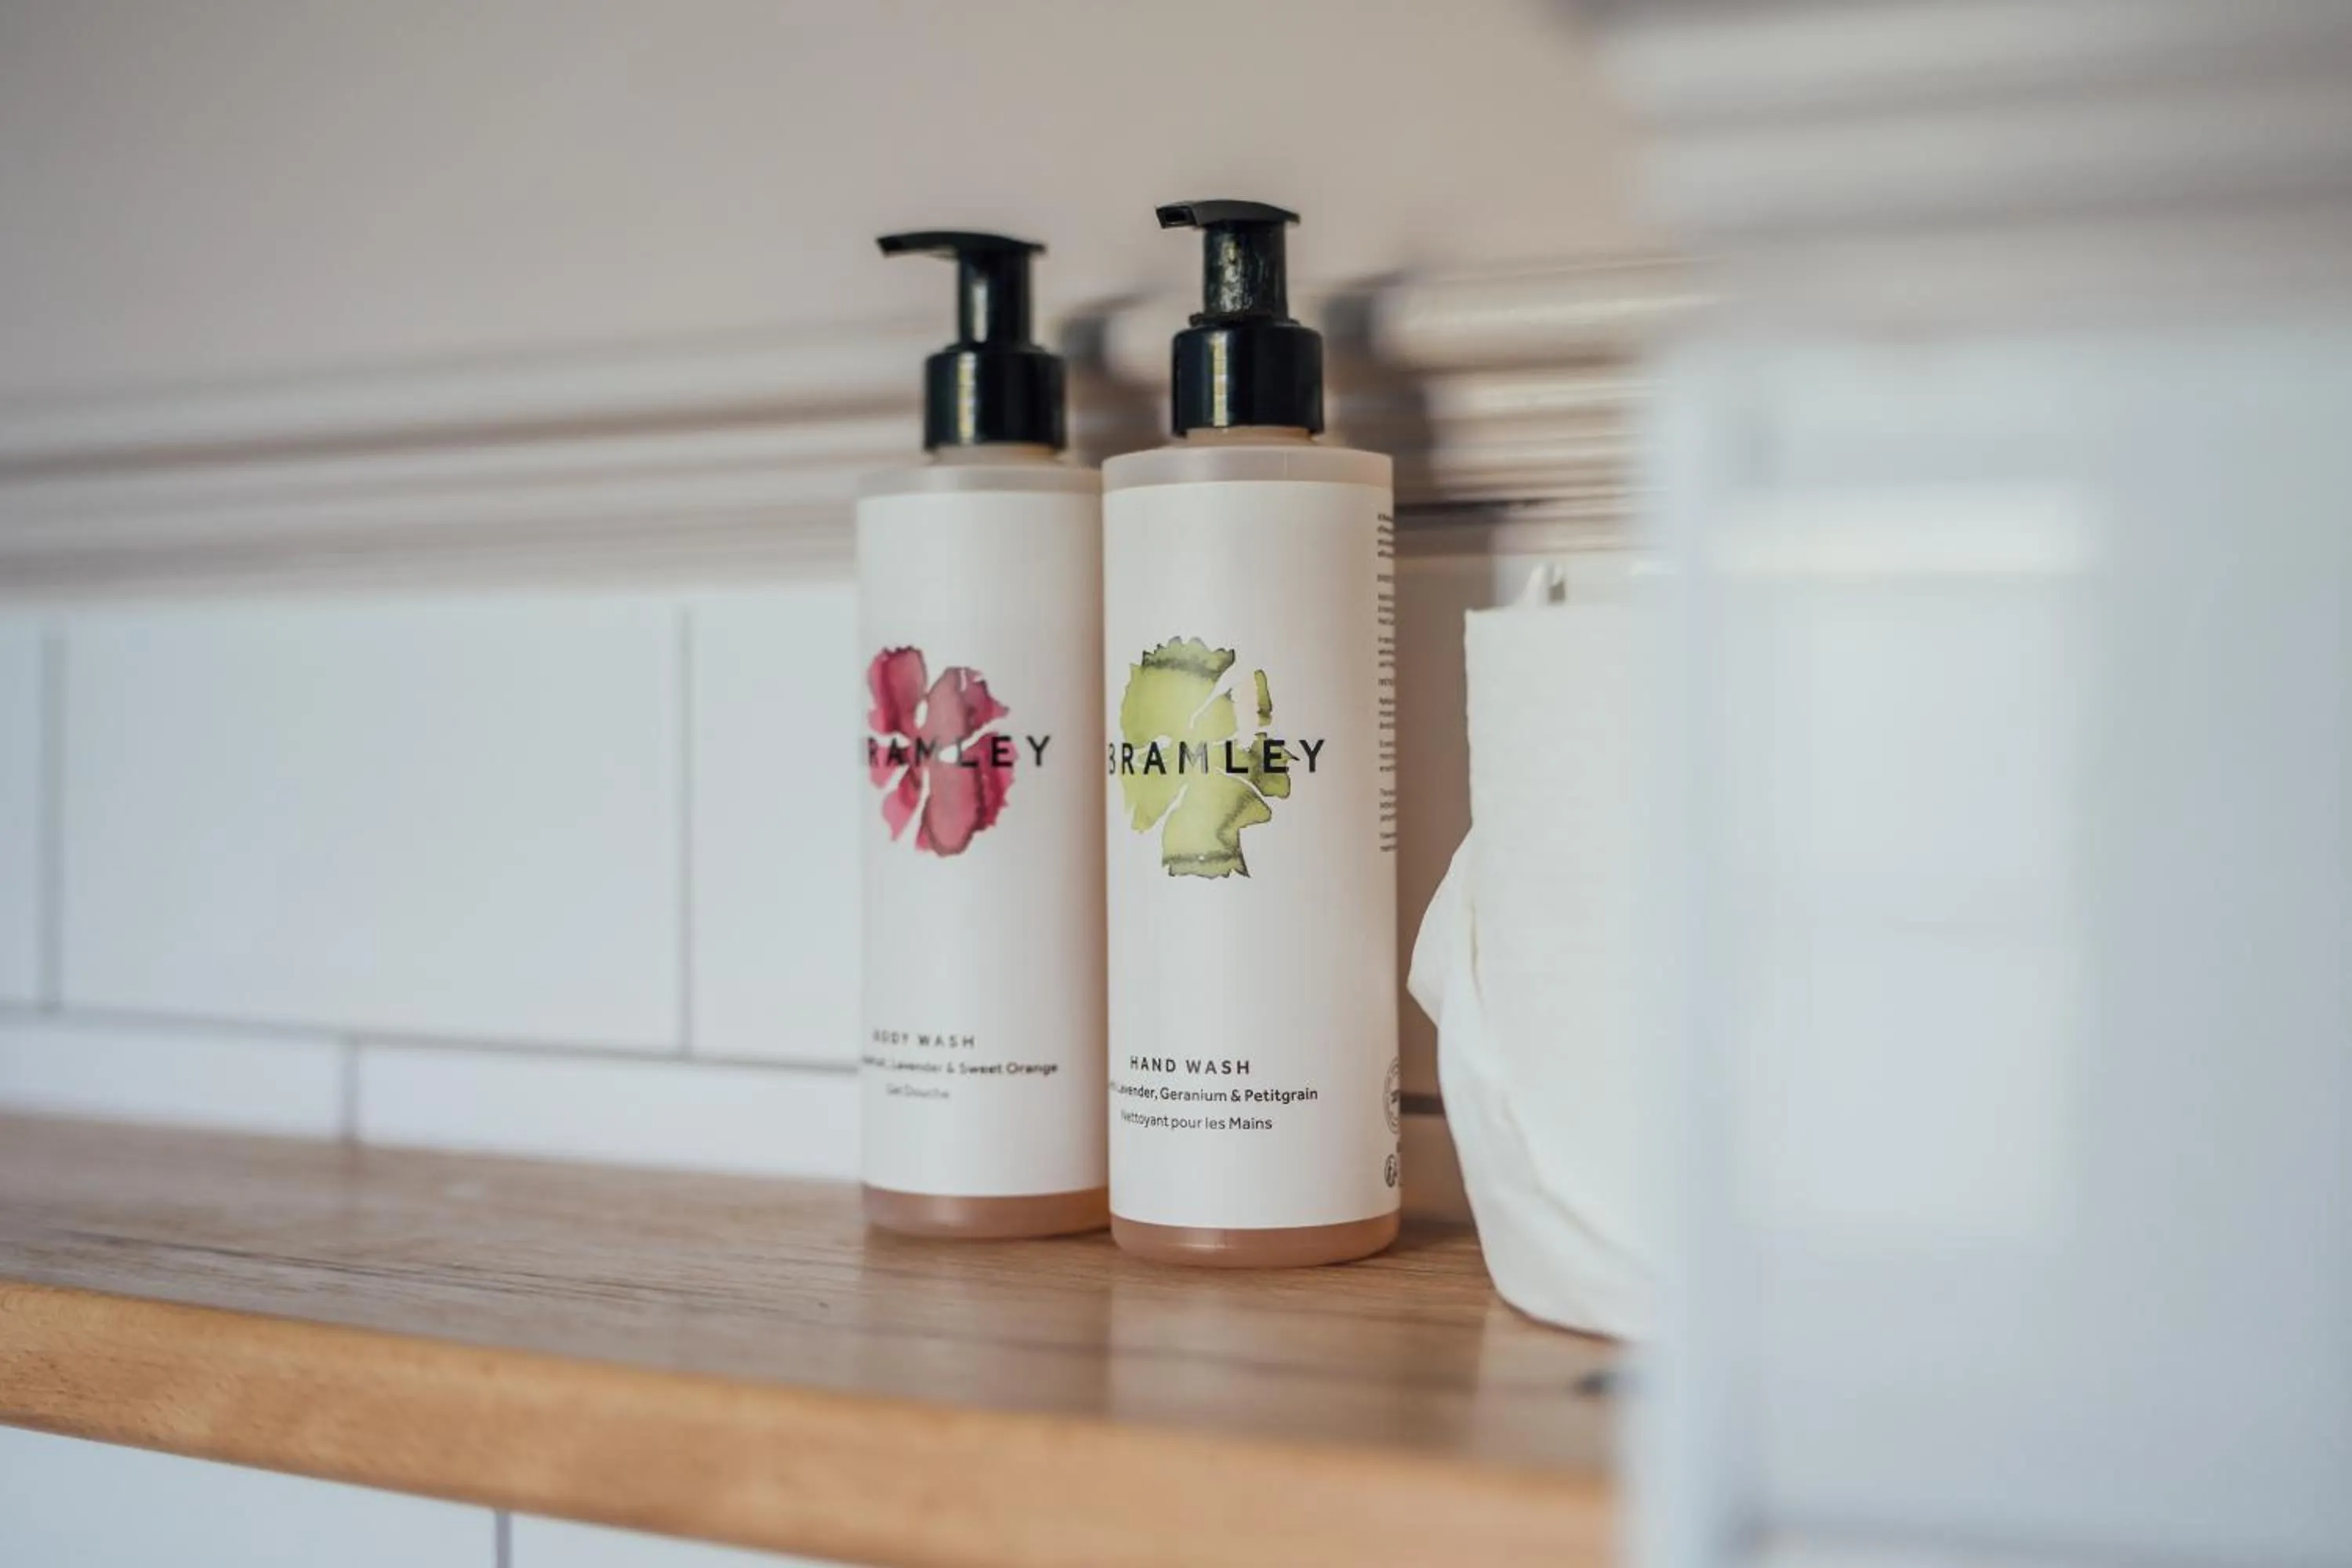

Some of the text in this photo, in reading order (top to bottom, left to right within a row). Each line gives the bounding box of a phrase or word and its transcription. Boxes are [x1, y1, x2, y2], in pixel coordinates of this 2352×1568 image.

[860, 734, 1051, 768] RAMLEY
[1108, 739, 1326, 775] BRAMLEY
[917, 1034, 975, 1048] WASH
[946, 1061, 955, 1074] &
[959, 1062, 1002, 1075] Sweet
[1006, 1062, 1058, 1076] Orange
[1130, 1055, 1250, 1075] HAND WASH
[1160, 1087, 1227, 1102] Geranium
[1231, 1089, 1241, 1102] &
[1245, 1087, 1318, 1105] Petitgrain
[1171, 1118, 1202, 1131] pour
[1205, 1116, 1225, 1130] les
[1229, 1116, 1273, 1130] Mains
